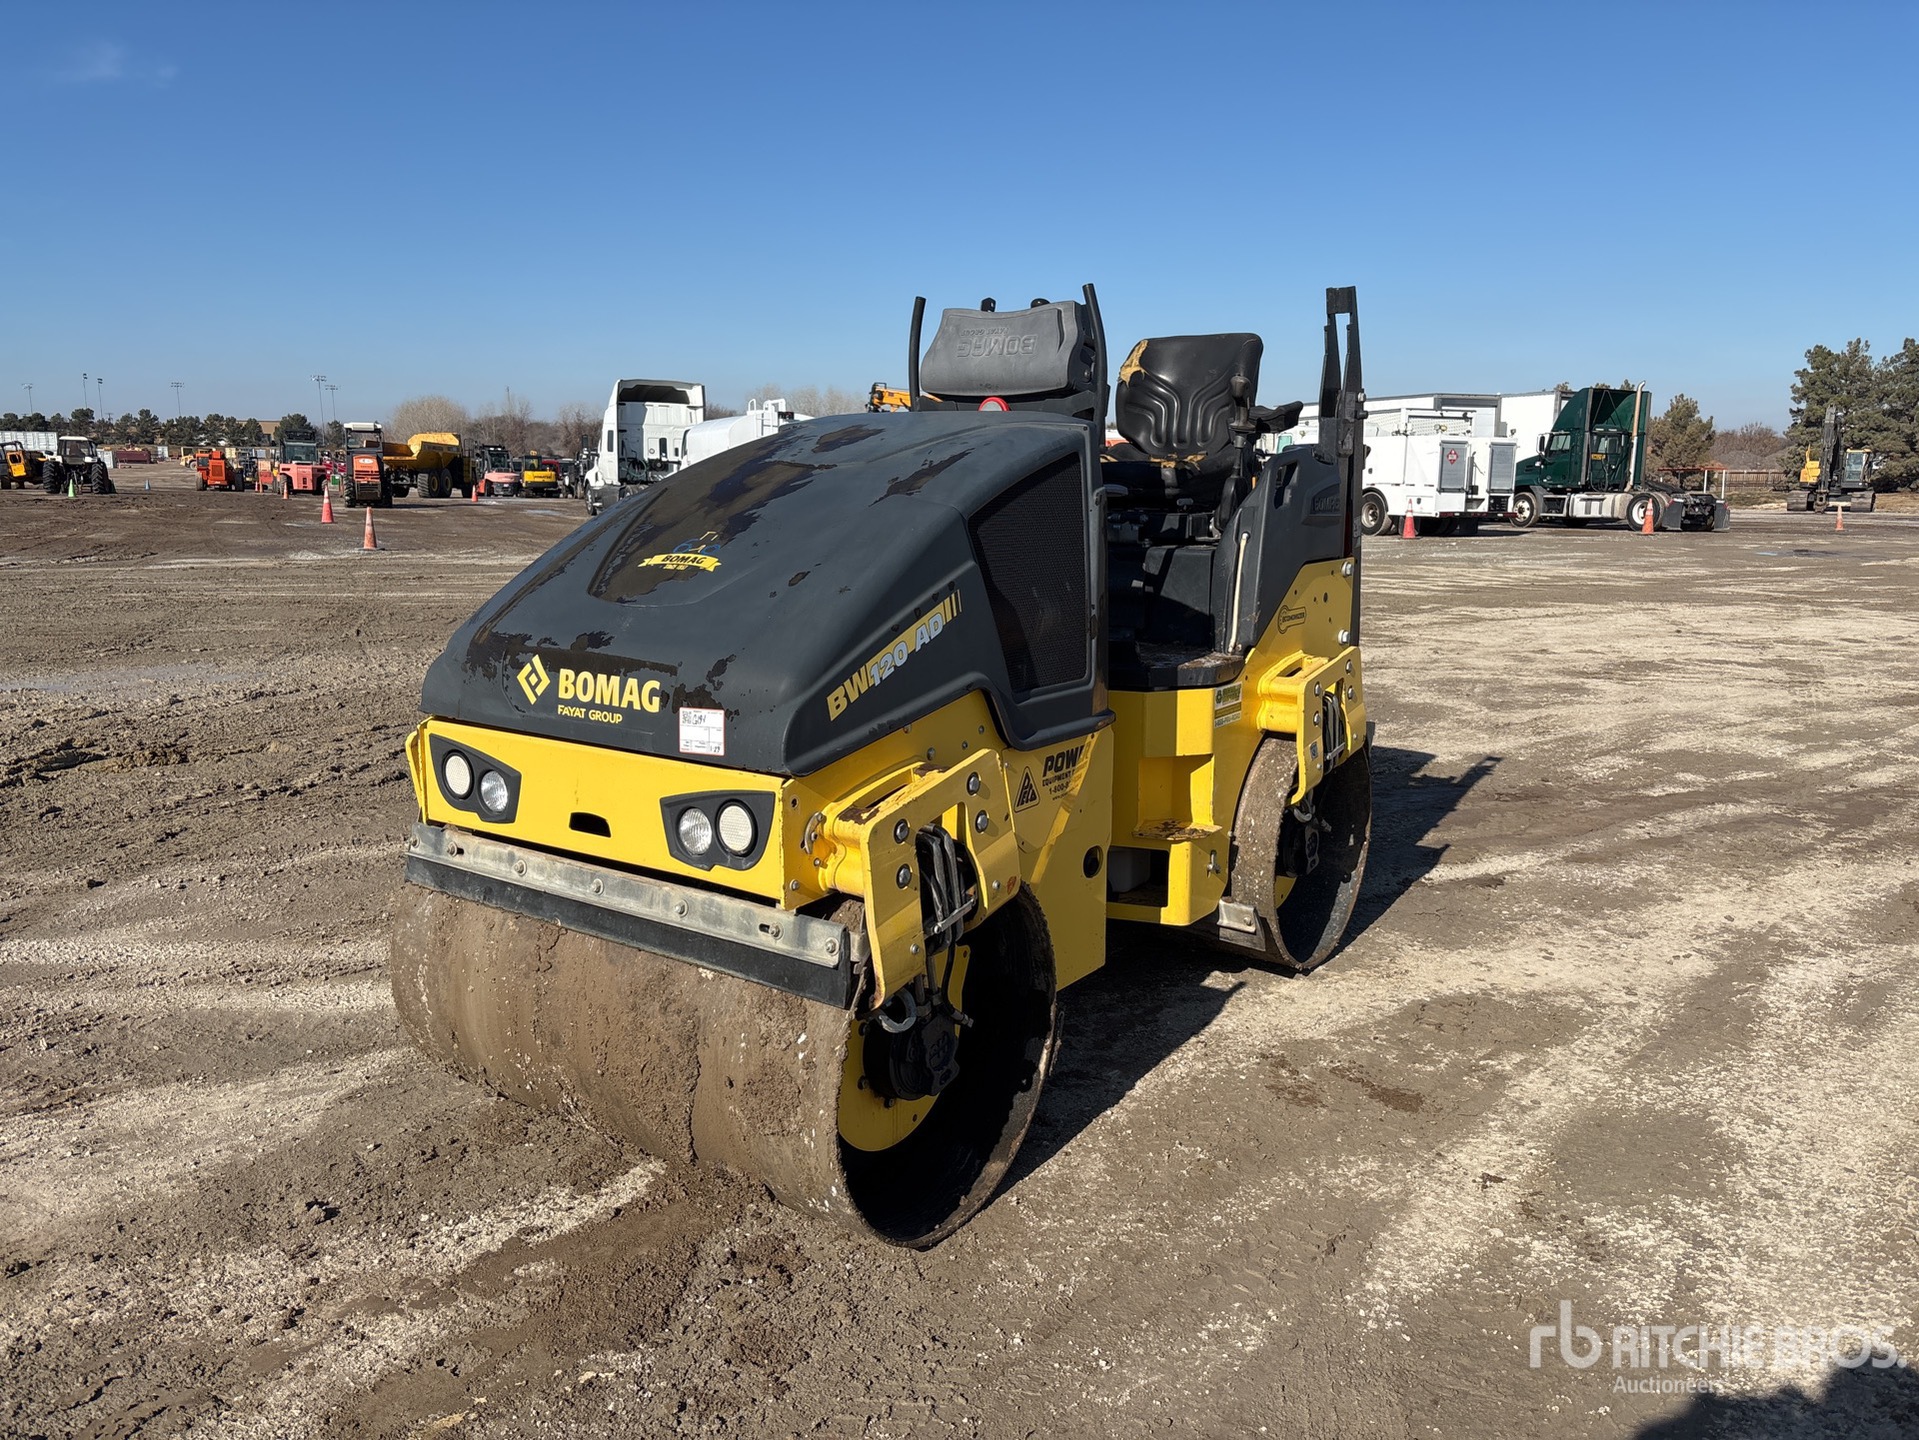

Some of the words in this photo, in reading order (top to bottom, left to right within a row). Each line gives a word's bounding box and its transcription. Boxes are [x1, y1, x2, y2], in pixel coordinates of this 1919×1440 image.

[957, 335, 1038, 358] BOMAG
[661, 555, 707, 564] BOMAG
[915, 612, 944, 653] AD
[558, 668, 661, 713] BOMAG
[557, 704, 587, 719] FAYAT
[588, 709, 623, 724] GROUP
